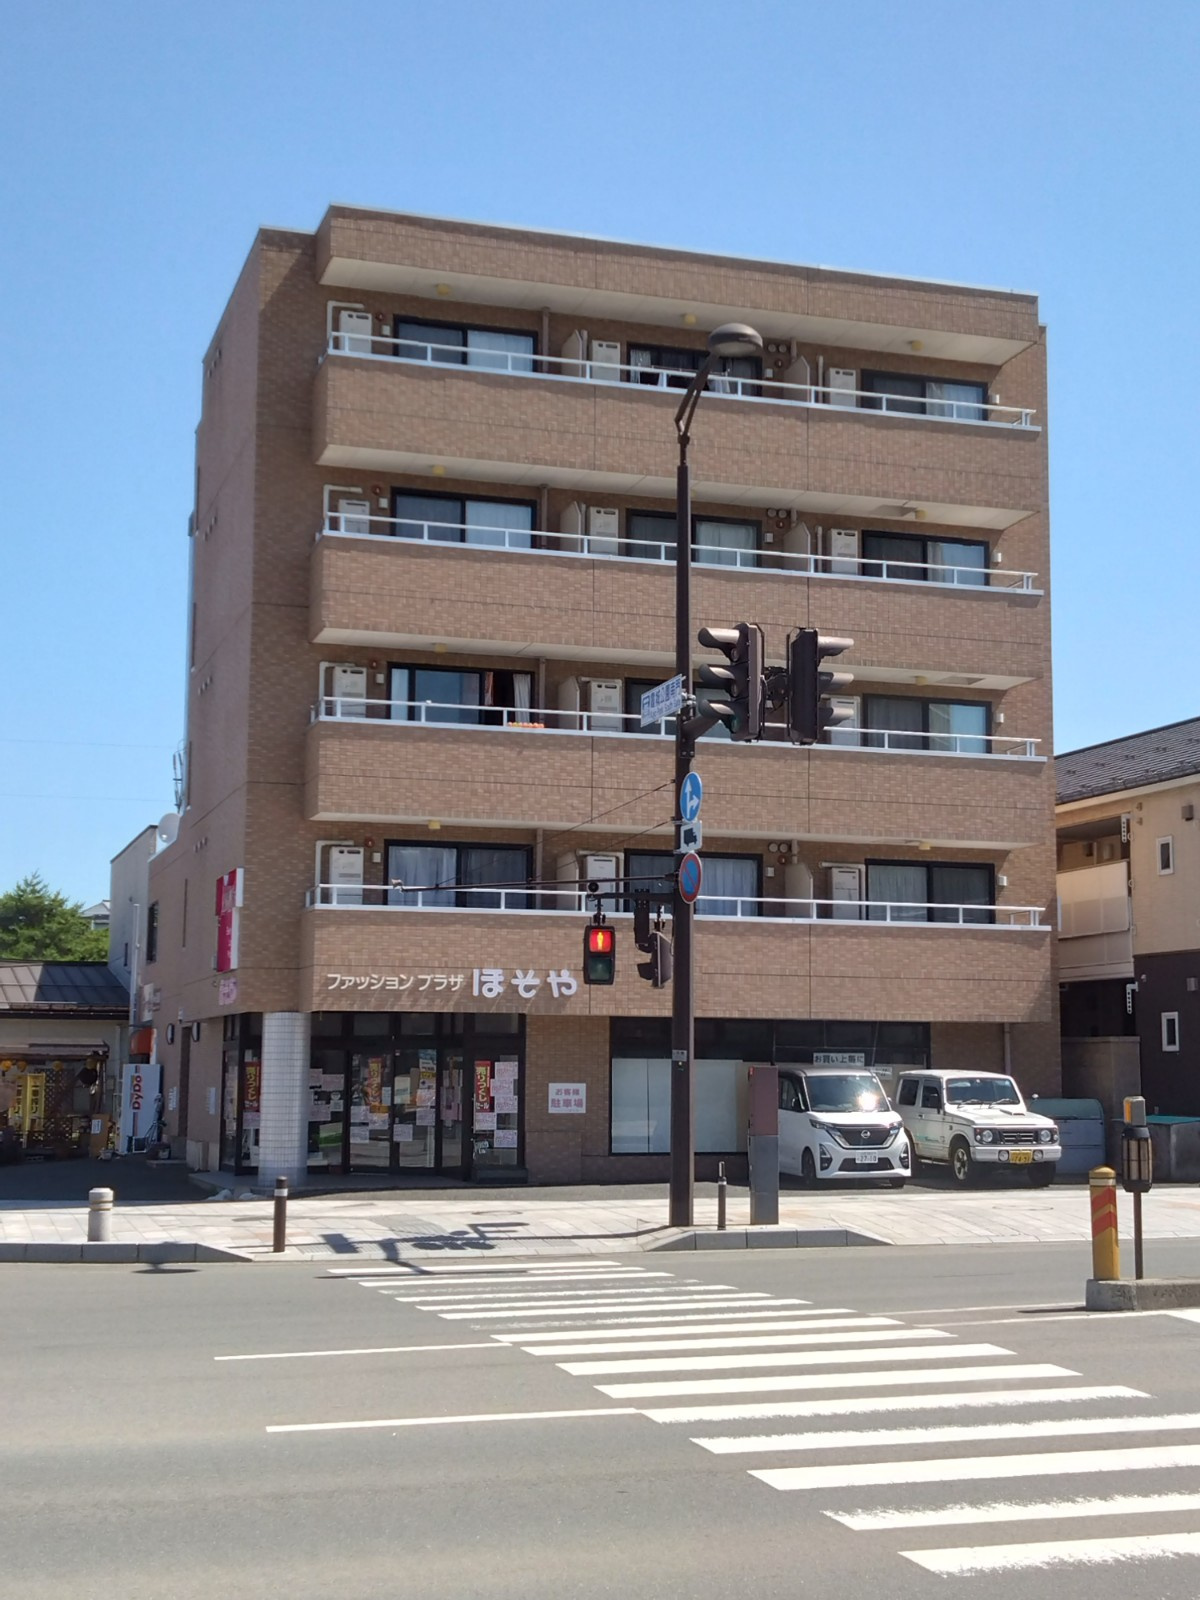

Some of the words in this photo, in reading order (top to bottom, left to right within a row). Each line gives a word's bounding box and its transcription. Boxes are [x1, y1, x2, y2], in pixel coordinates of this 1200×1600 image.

[327, 973, 414, 991] ファッション
[418, 973, 464, 992] プラザ
[472, 968, 578, 998] ほそや
[132, 1075, 144, 1110] DyDo
[476, 1066, 488, 1102] 売りつくし
[551, 1098, 583, 1108] 駐車場
